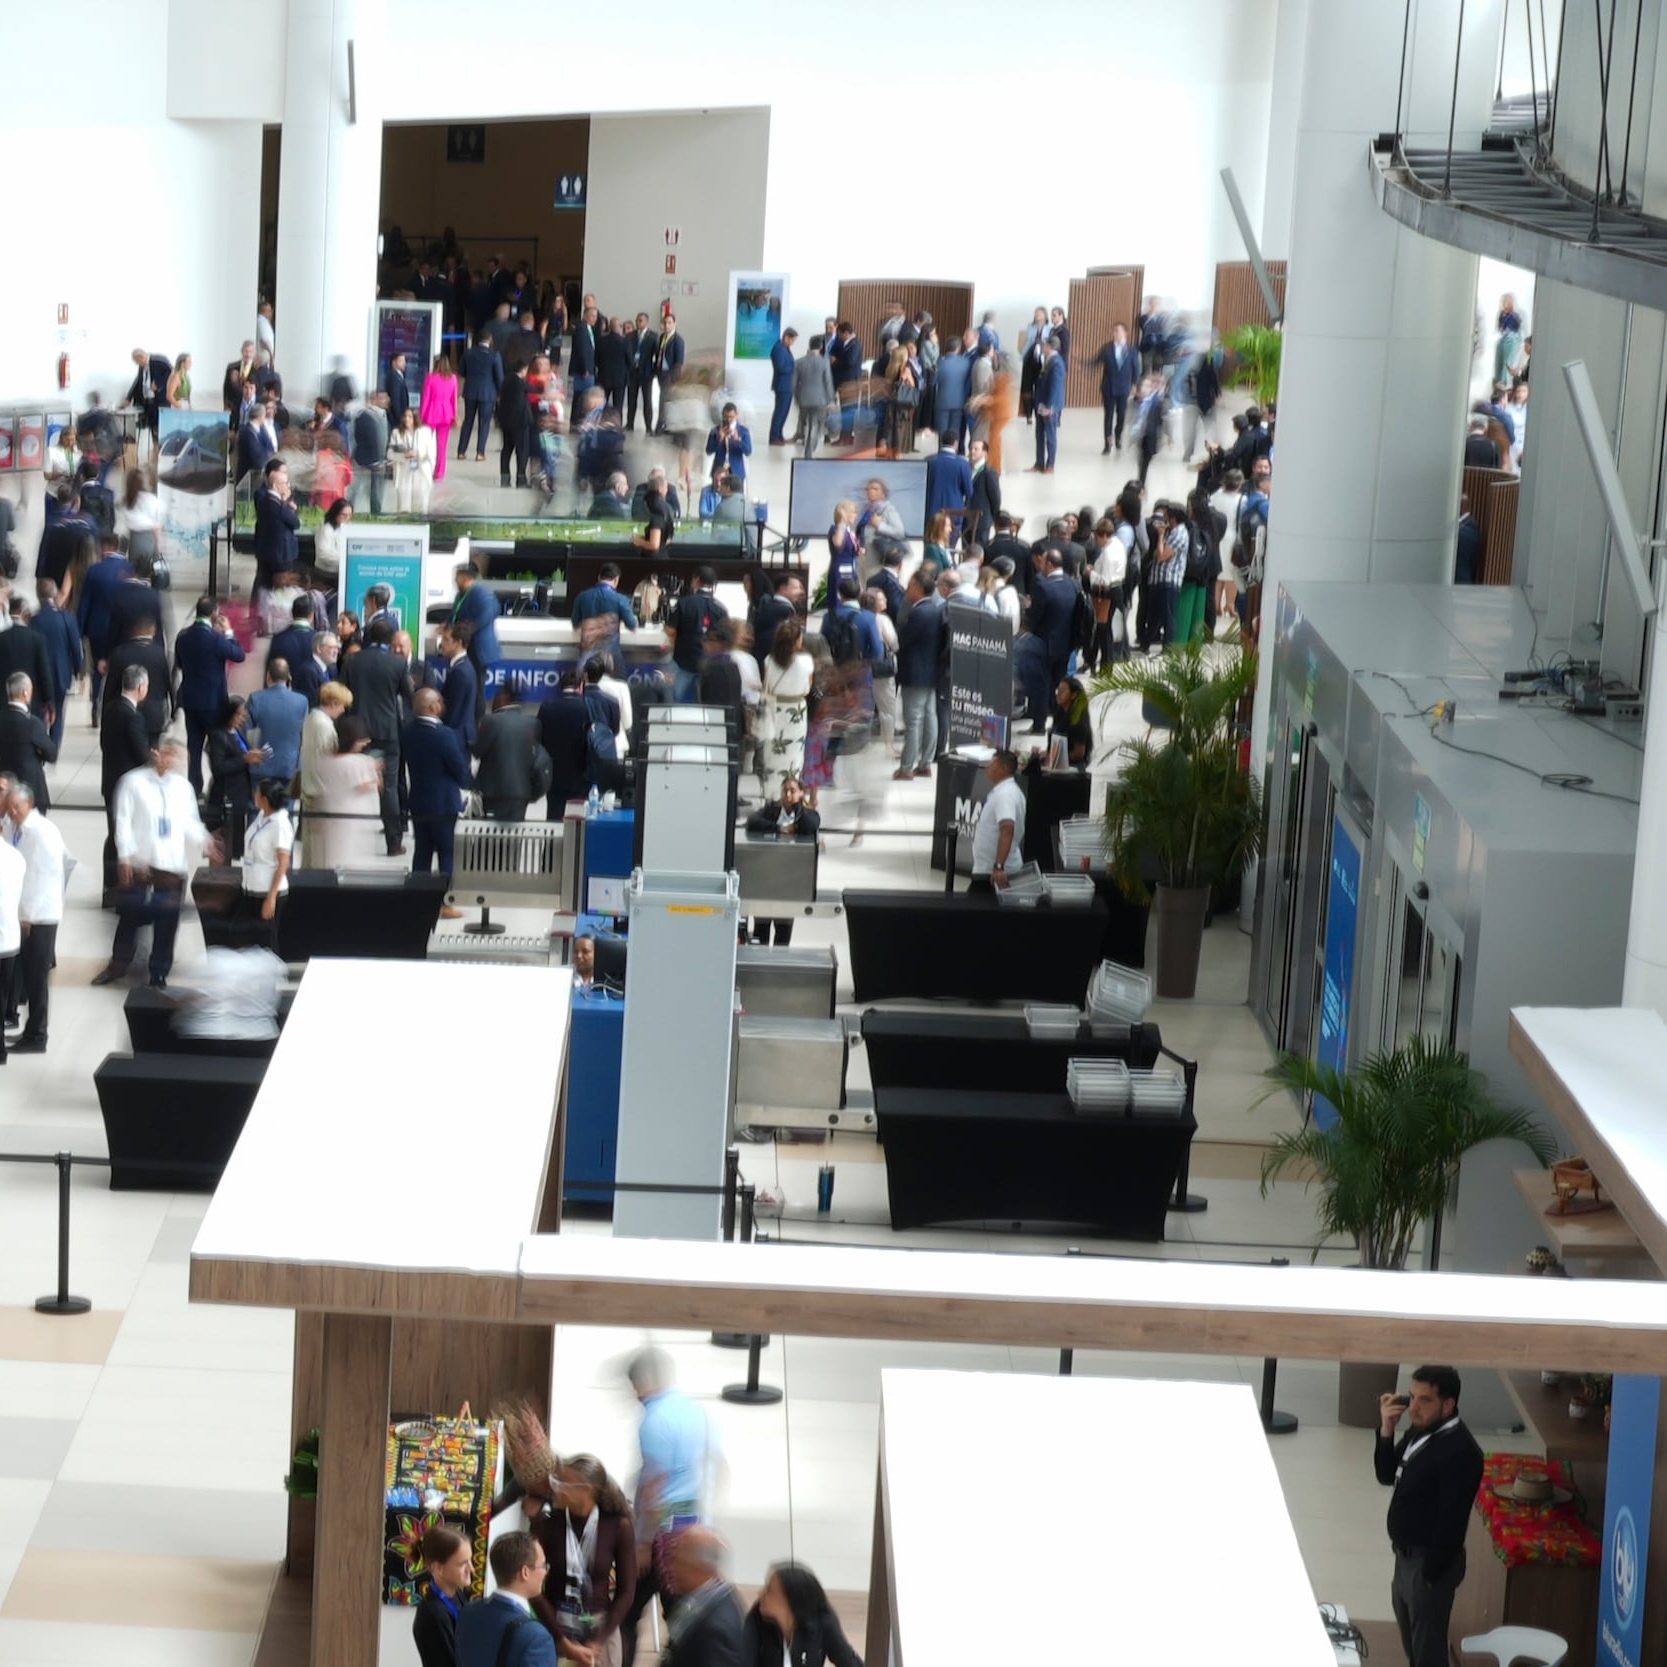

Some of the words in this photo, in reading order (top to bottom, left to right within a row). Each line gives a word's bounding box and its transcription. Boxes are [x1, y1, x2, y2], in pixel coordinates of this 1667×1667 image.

[952, 631, 971, 647] MAC
[972, 636, 1007, 653] PANAMÁ
[952, 685, 971, 700] Este
[972, 691, 982, 703] es
[951, 699, 962, 712] tu
[964, 703, 994, 718] museo
[955, 796, 982, 825] MA
